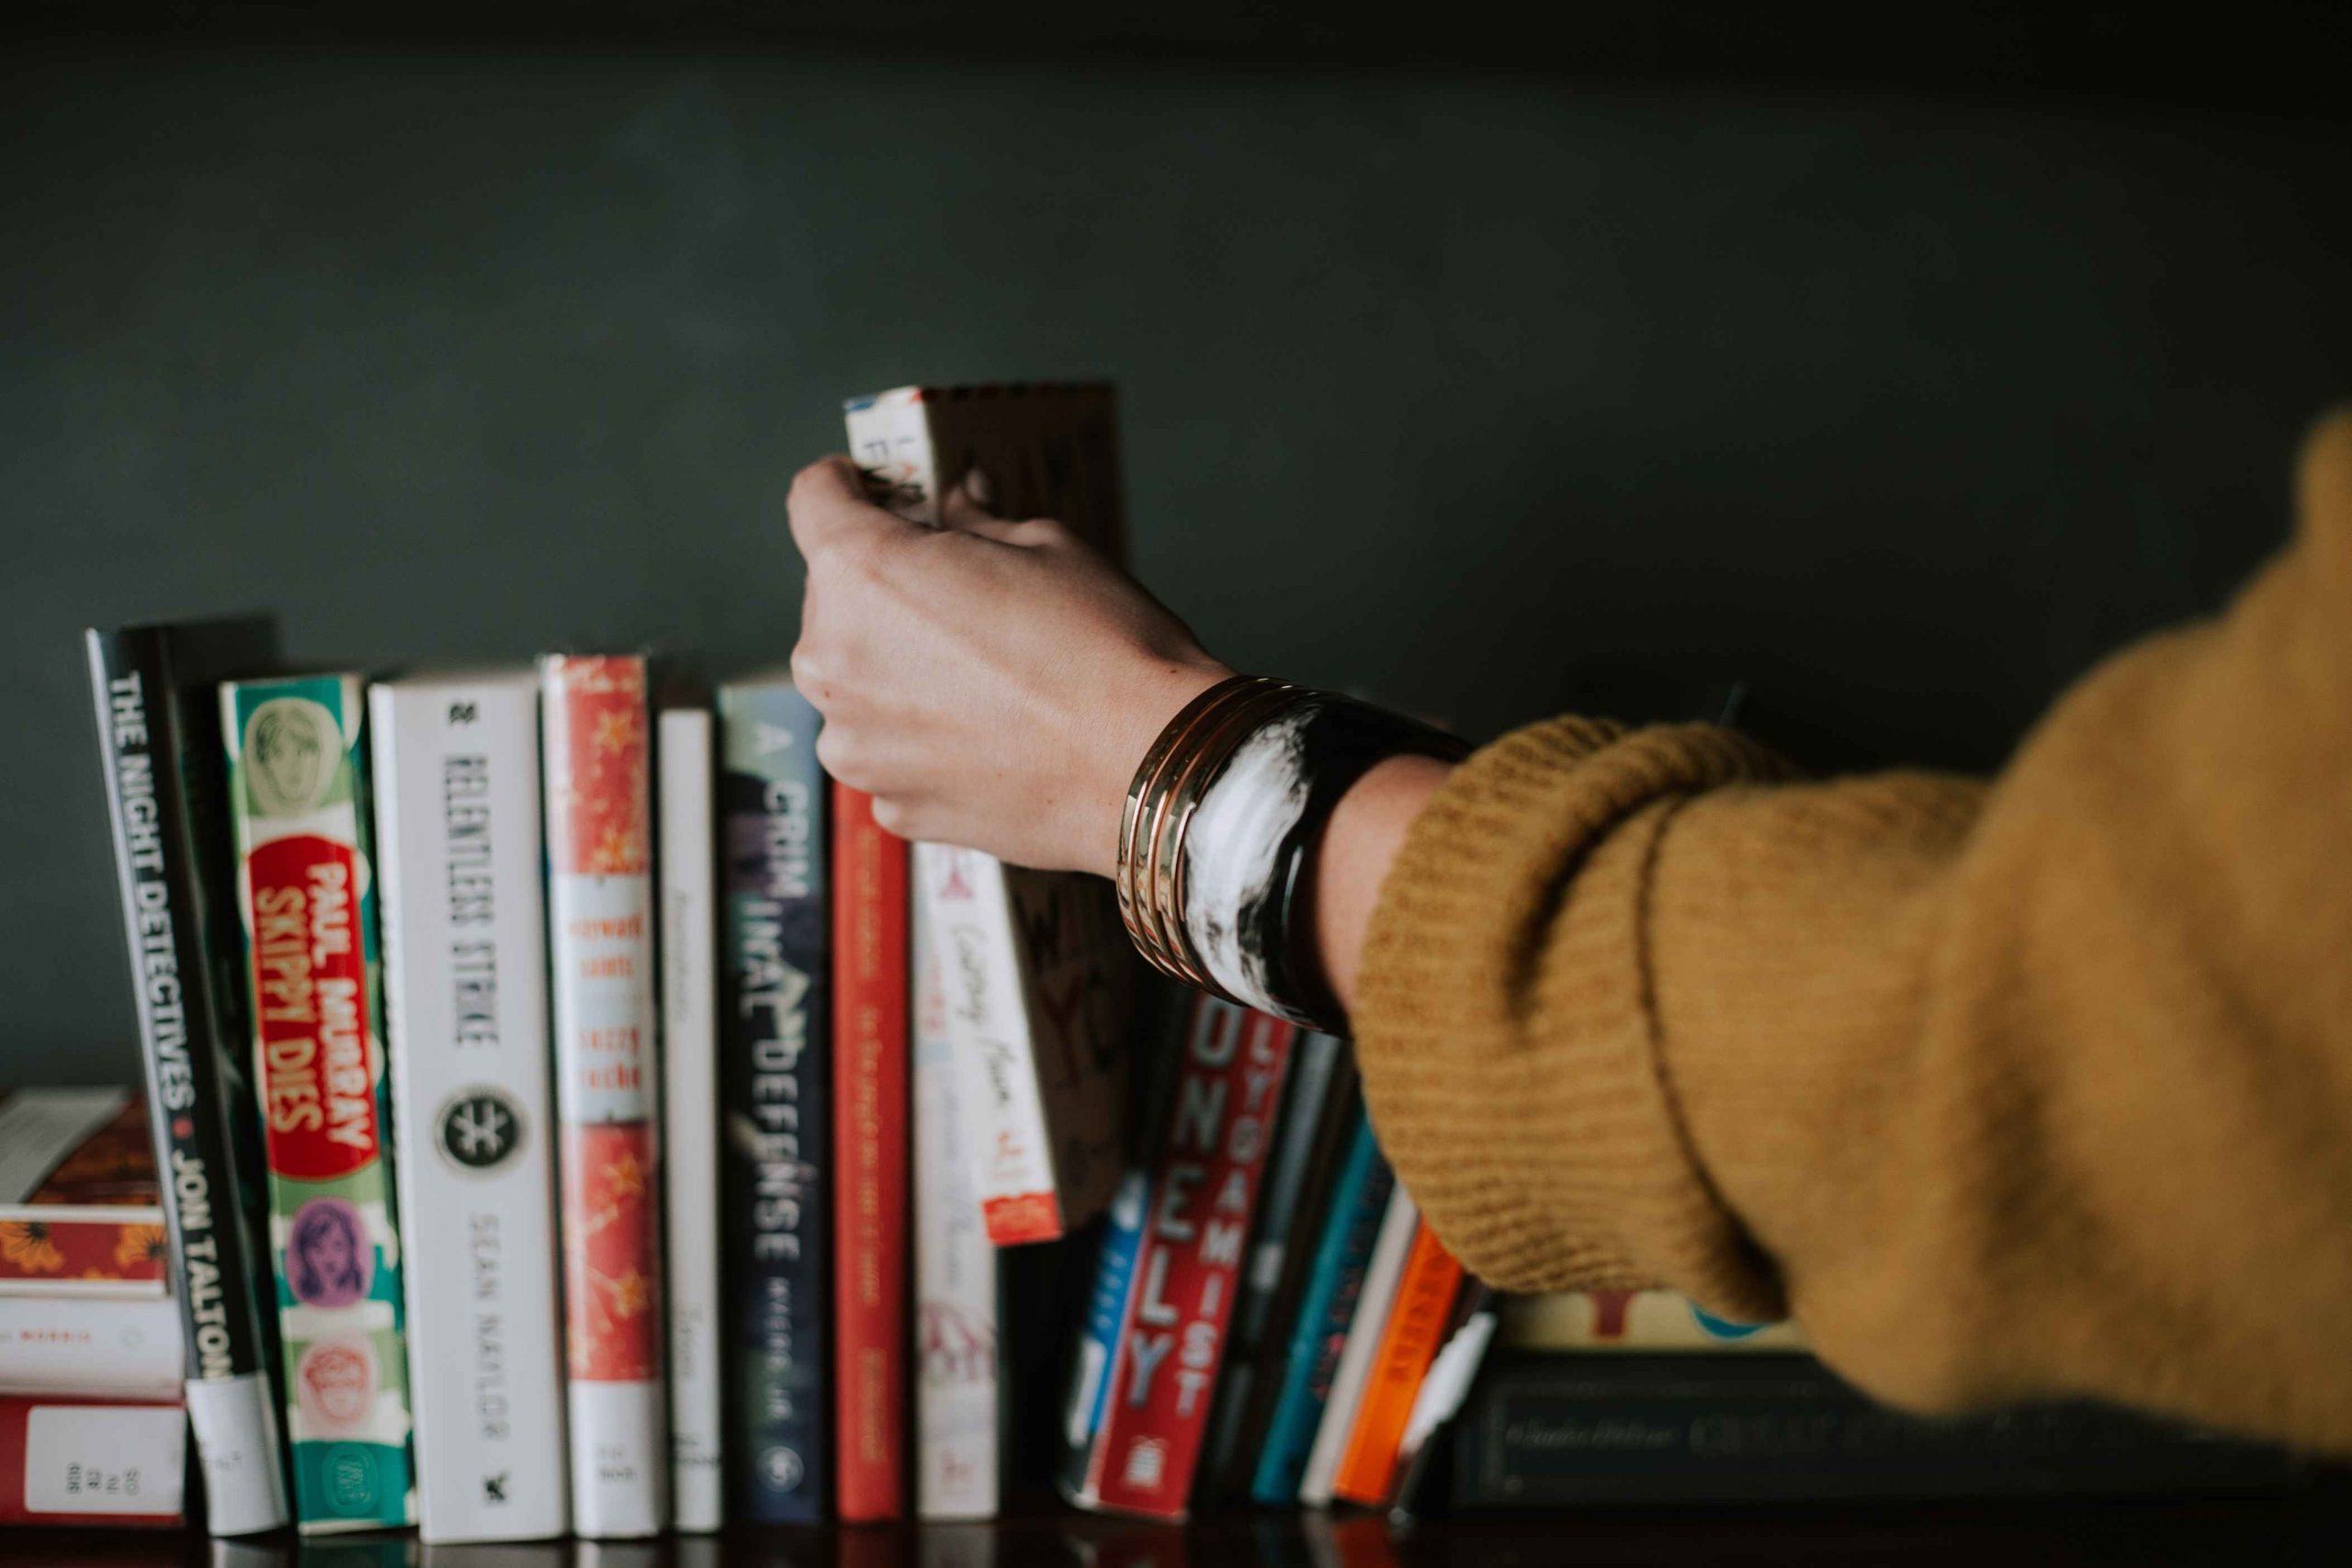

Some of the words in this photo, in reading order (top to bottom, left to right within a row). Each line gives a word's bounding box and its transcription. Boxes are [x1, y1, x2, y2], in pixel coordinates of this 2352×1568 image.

[109, 671, 147, 748] THE
[756, 724, 793, 754] A
[117, 760, 164, 875] NIGHT
[444, 754, 495, 927] RELENTLESS
[254, 885, 318, 1022] SKIPPY
[305, 861, 349, 969] PAUL
[137, 881, 197, 1110] DETECTIVES
[451, 943, 500, 1048] STRIKE
[266, 1034, 324, 1135] DIES
[317, 976, 373, 1152] MURRAY
[172, 1150, 211, 1229] JON
[753, 1038, 800, 1262] DEFENSE
[1126, 997, 1250, 1411] ONELY
[467, 1213, 500, 1301] SEAN
[1175, 1014, 1278, 1416] LYGAMIST
[186, 1235, 233, 1380] TALTON
